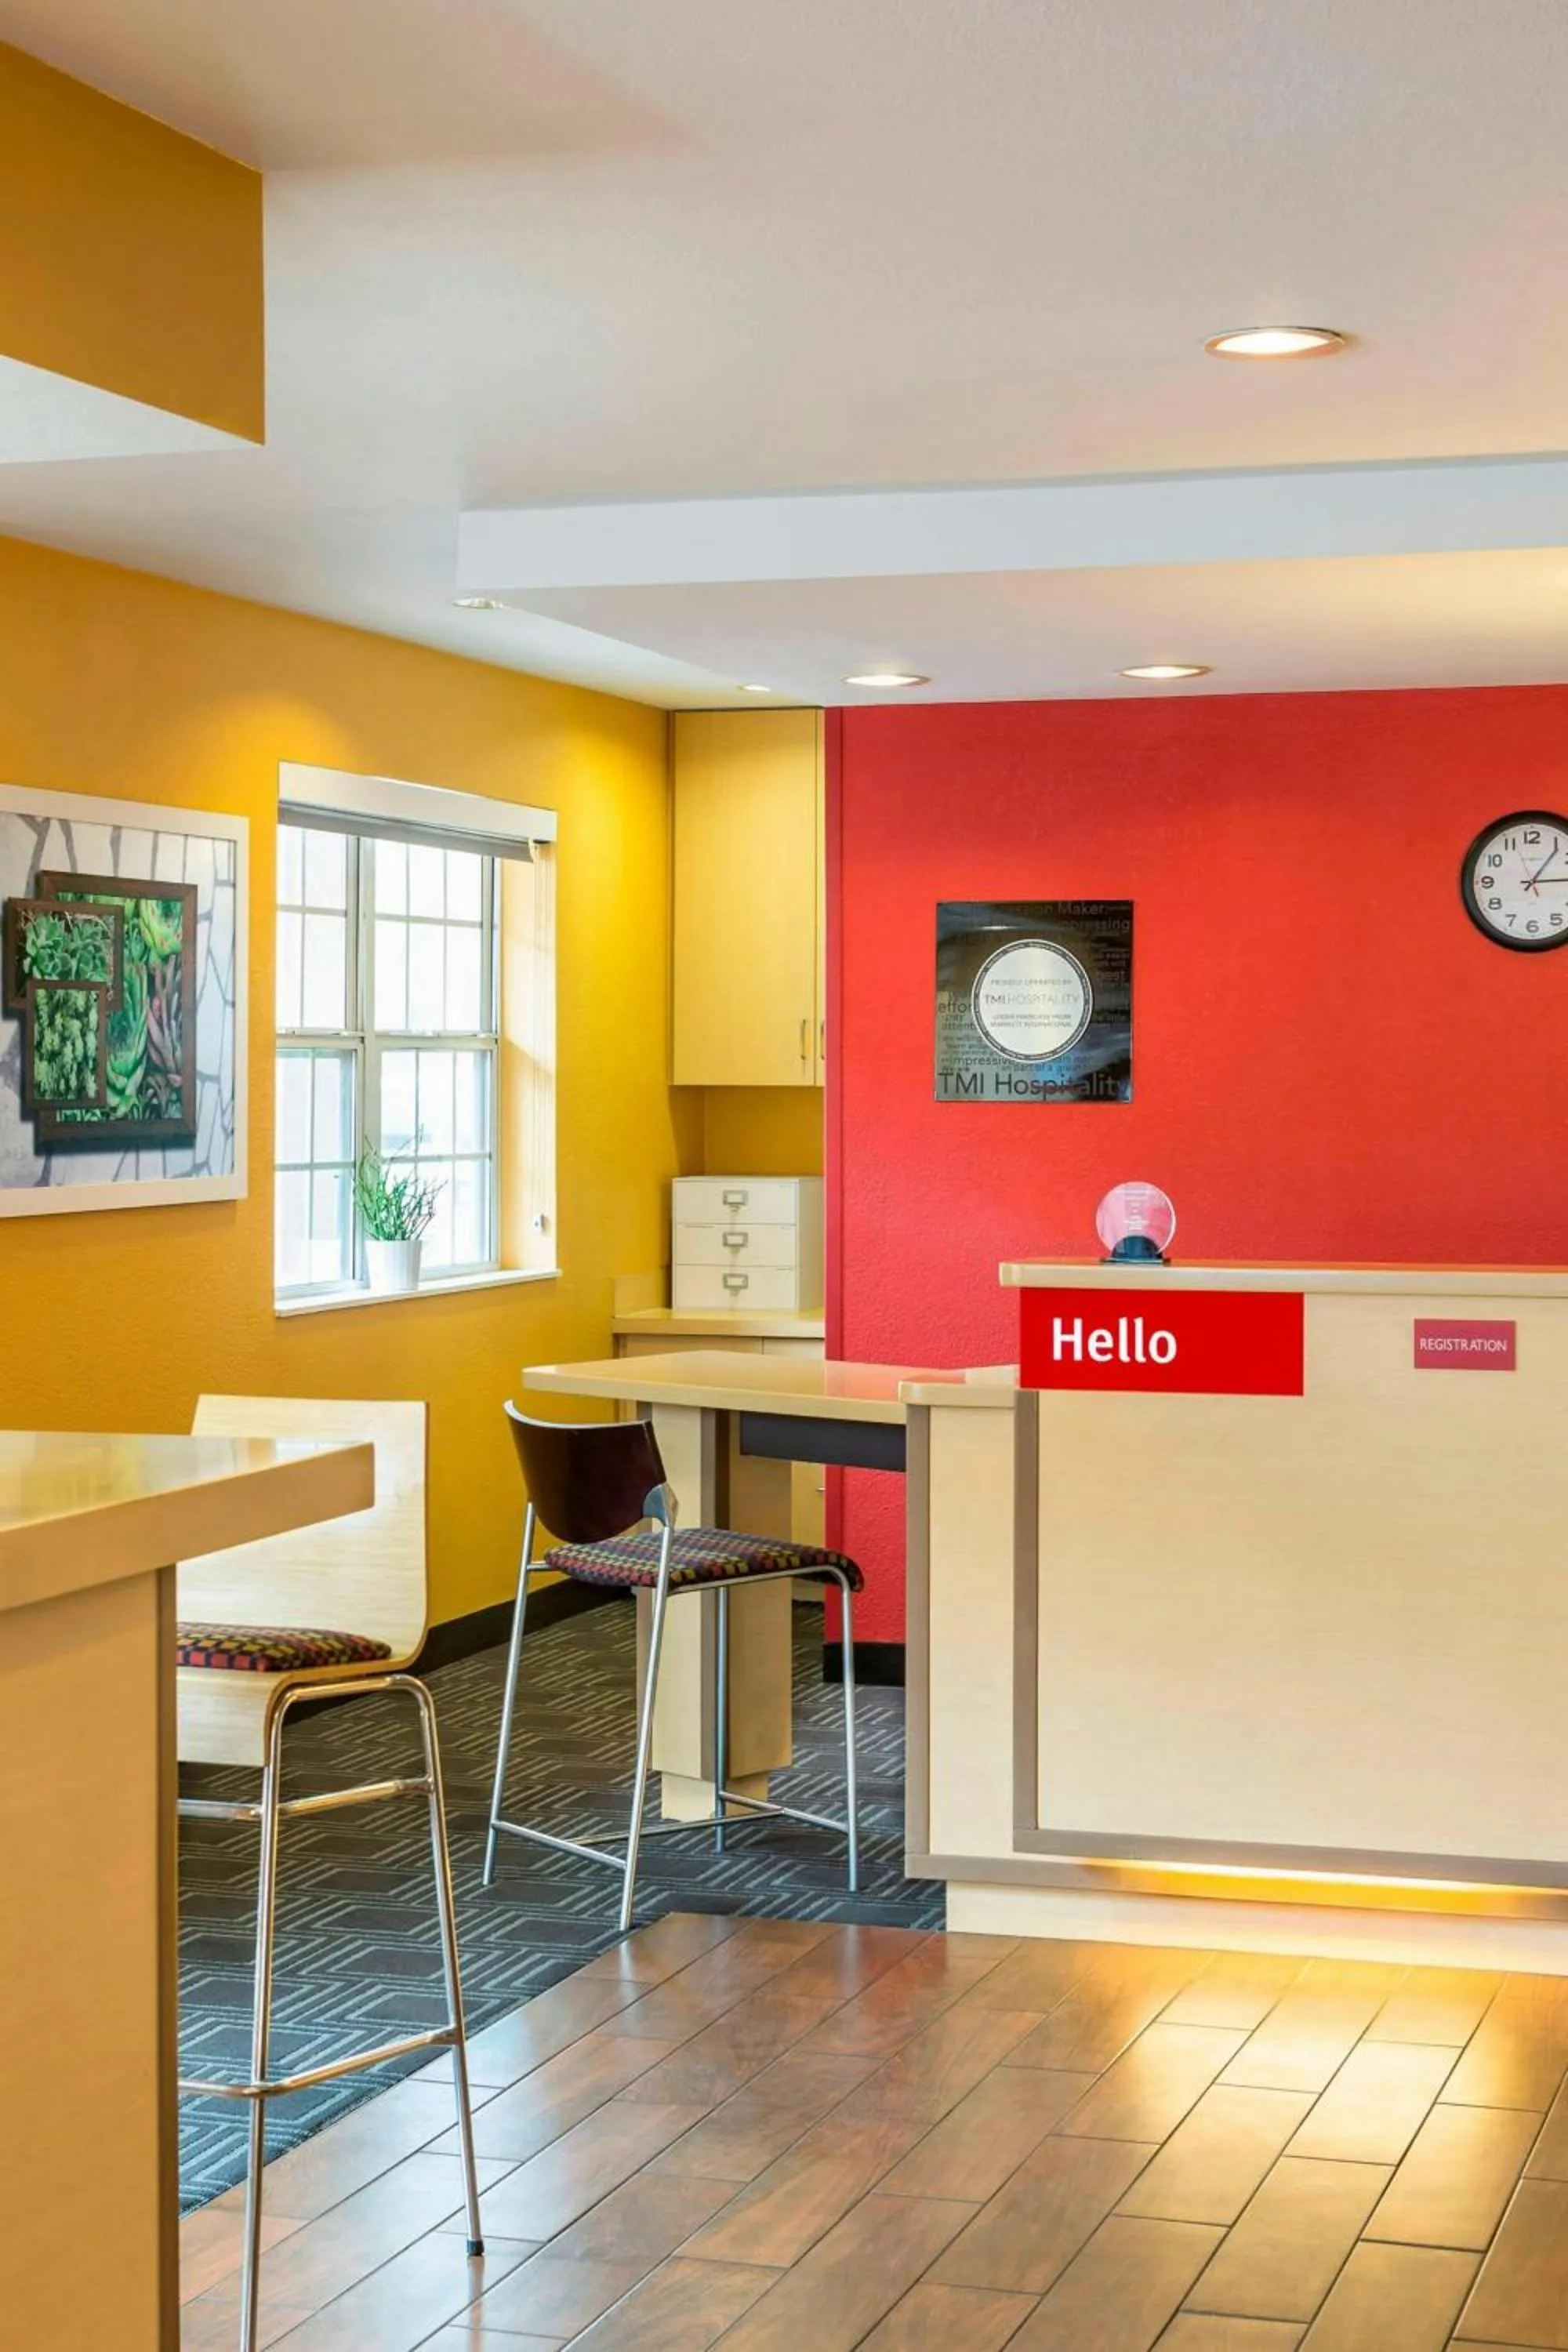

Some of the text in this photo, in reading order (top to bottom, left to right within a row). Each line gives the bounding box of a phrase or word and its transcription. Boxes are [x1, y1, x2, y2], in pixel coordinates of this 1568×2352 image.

[1523, 830, 1541, 844] 12
[1504, 838, 1515, 851] 11
[1487, 854, 1503, 868] 10
[1481, 876, 1495, 888] 9
[1488, 898, 1502, 910] 8
[1505, 913, 1517, 927] 7
[1549, 913, 1563, 926] 5
[1526, 920, 1539, 933] 6
[985, 993, 1005, 1004] TMI
[938, 1072, 1130, 1101] TMI Hospitality
[1052, 1317, 1177, 1364] Hello
[1420, 1338, 1507, 1353] REGISTRATION
